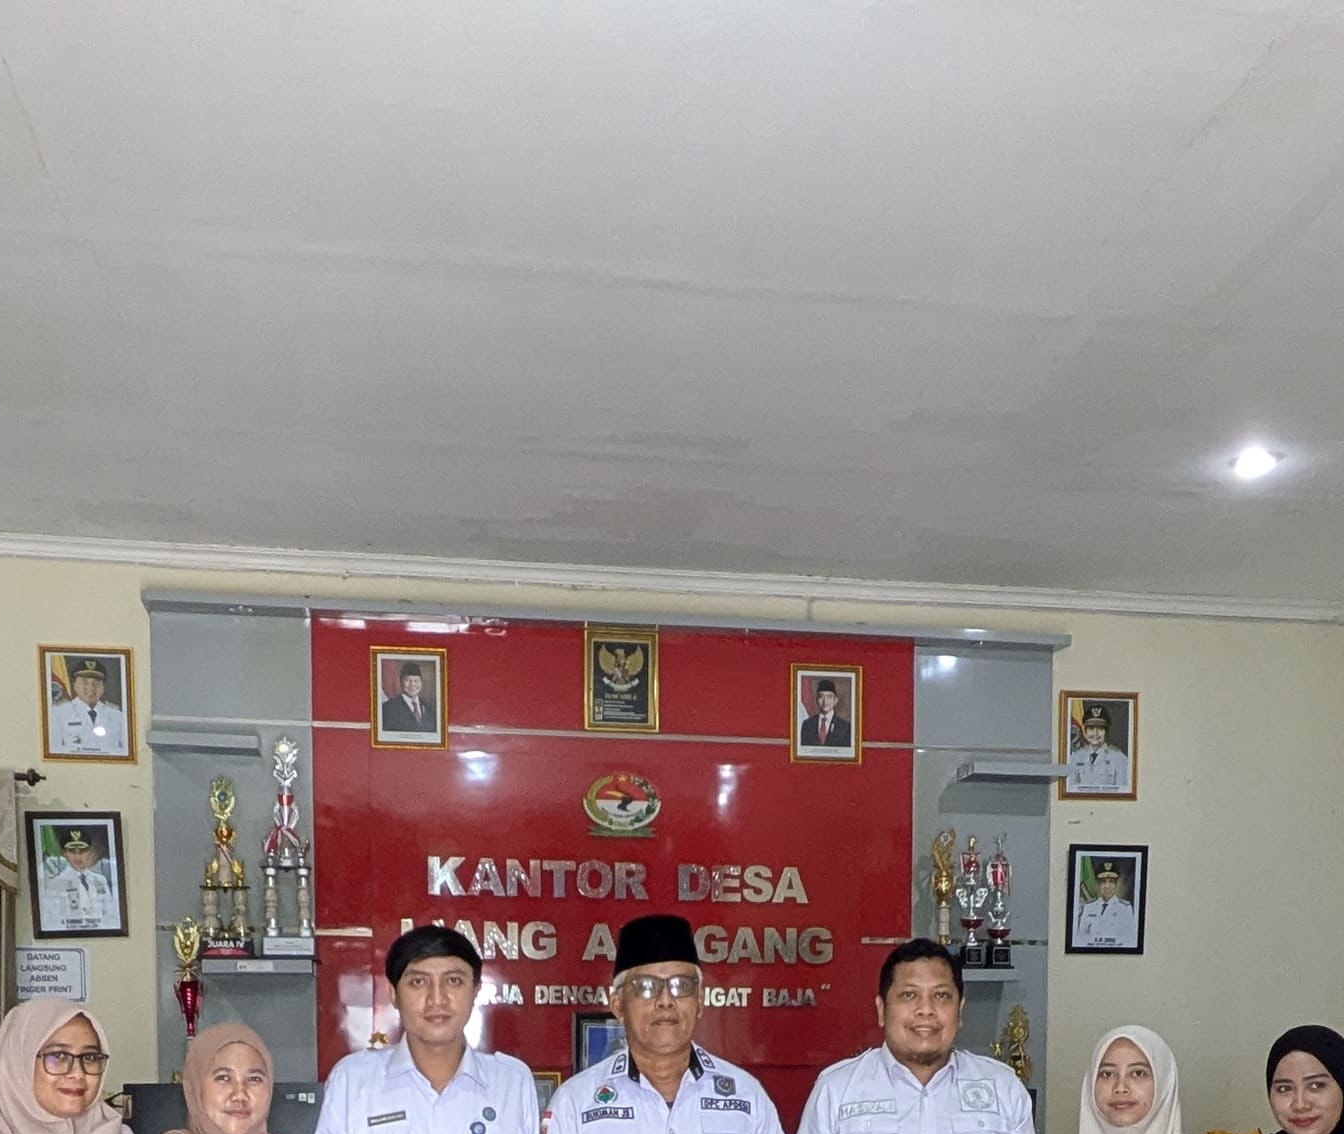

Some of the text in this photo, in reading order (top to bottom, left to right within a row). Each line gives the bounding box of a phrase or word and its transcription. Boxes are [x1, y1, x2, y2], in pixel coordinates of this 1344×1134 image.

[427, 855, 809, 905] KANTOR DESA
[208, 939, 235, 948] JUARA
[581, 922, 834, 965] AGANG
[27, 953, 61, 961] DATANG
[20, 964, 67, 973] LANGSUNG
[30, 974, 58, 982] ABSEN
[48, 985, 72, 994] PRINT
[535, 985, 613, 1006] DENGA
